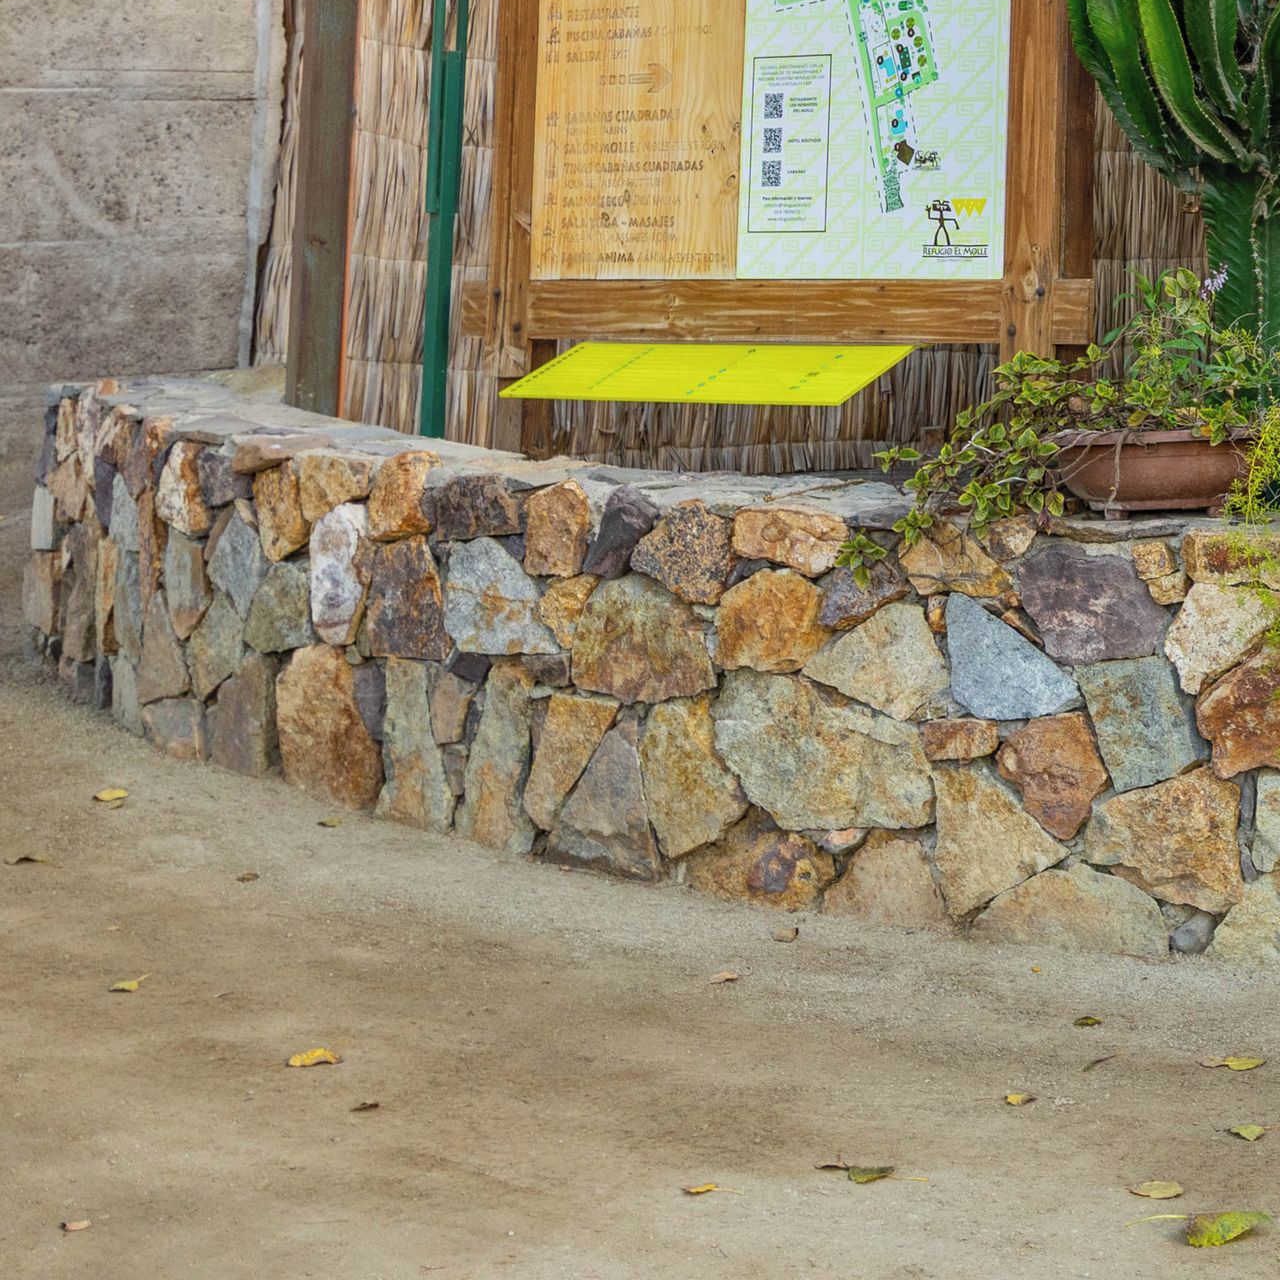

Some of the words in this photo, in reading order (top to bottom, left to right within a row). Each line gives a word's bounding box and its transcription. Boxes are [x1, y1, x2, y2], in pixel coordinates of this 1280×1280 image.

[567, 6, 640, 22] RESTAURANTE
[566, 28, 604, 43] PISCINA
[606, 26, 652, 41] CABAÑAS
[643, 159, 704, 172] CUADRADAS
[922, 247, 952, 256] REFUGIO
[954, 246, 962, 255] EL
[963, 247, 988, 256] MOLLE
